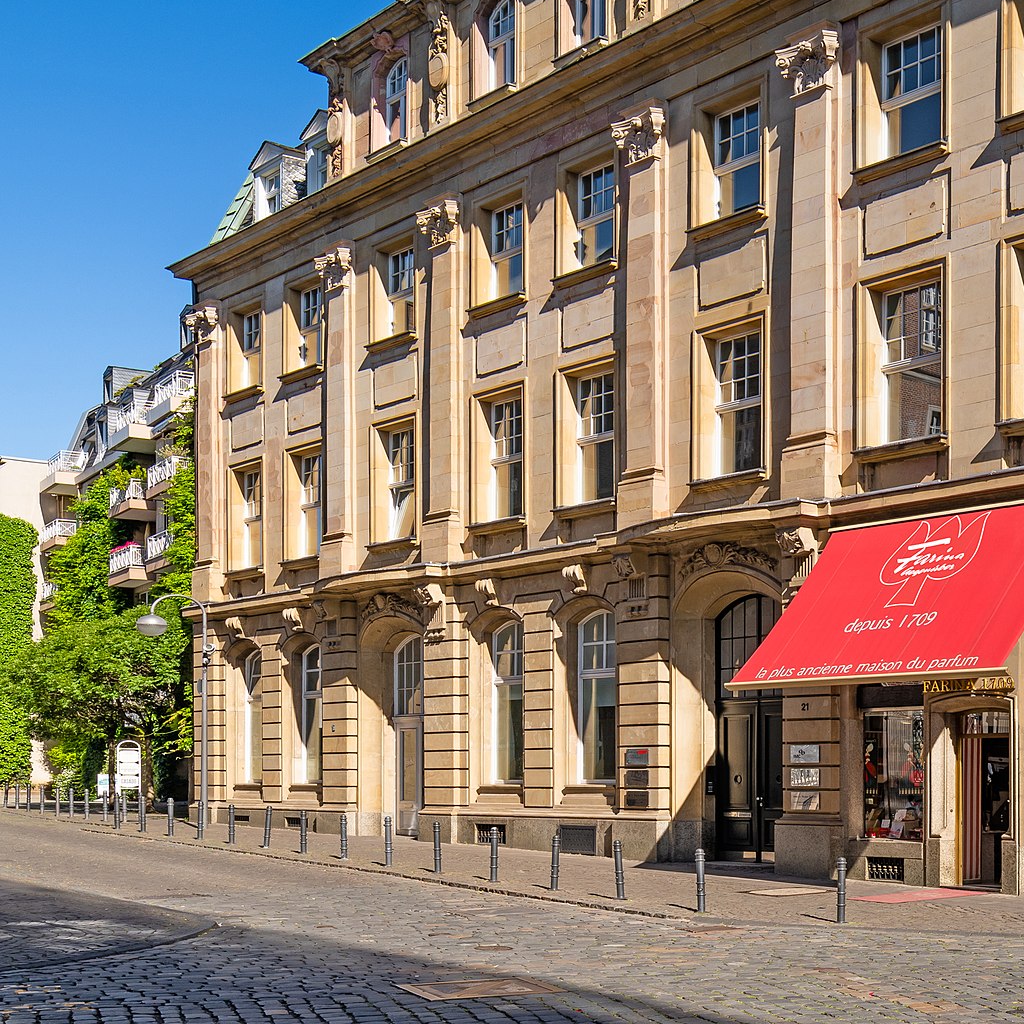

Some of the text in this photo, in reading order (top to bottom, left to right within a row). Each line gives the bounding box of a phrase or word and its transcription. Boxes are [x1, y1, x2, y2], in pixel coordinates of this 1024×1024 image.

[894, 537, 965, 574] Farina
[844, 611, 938, 634] depuis 1709
[755, 654, 979, 680] la plus ancienne maison du parfum
[923, 679, 977, 693] FARINA
[981, 677, 1014, 689] 1709
[801, 703, 809, 711] 21
